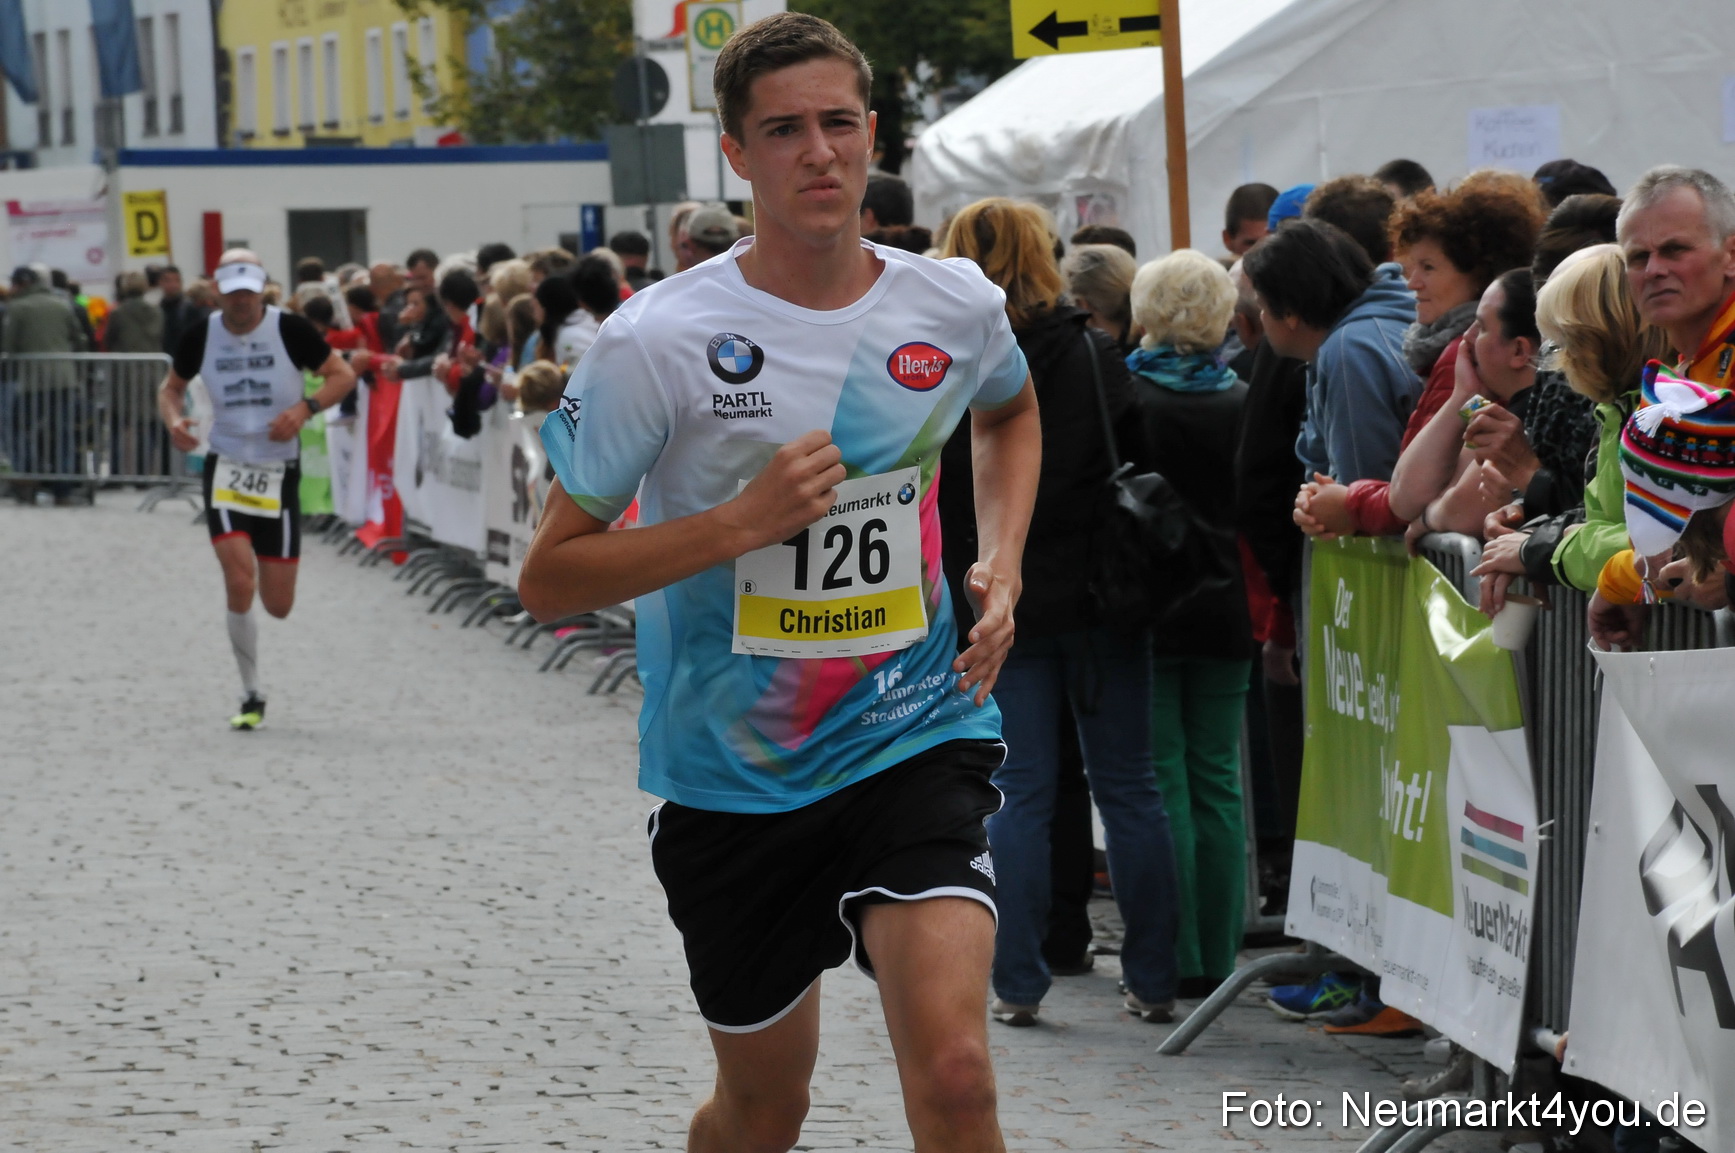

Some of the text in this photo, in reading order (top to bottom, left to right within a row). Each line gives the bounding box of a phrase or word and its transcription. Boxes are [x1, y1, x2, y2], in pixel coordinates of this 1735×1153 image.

[705, 18, 724, 39] H
[135, 210, 159, 242] D
[710, 333, 755, 349] BMW
[898, 355, 945, 377] Hervis
[712, 392, 772, 409] PARTL
[713, 407, 773, 420] Neumarkt
[228, 470, 269, 493] 246
[824, 492, 891, 518] eumarkt
[781, 518, 890, 591] 126
[744, 582, 752, 593] B
[1335, 577, 1353, 629] Der
[780, 606, 886, 634] Christian
[1323, 625, 1365, 721] Neue
